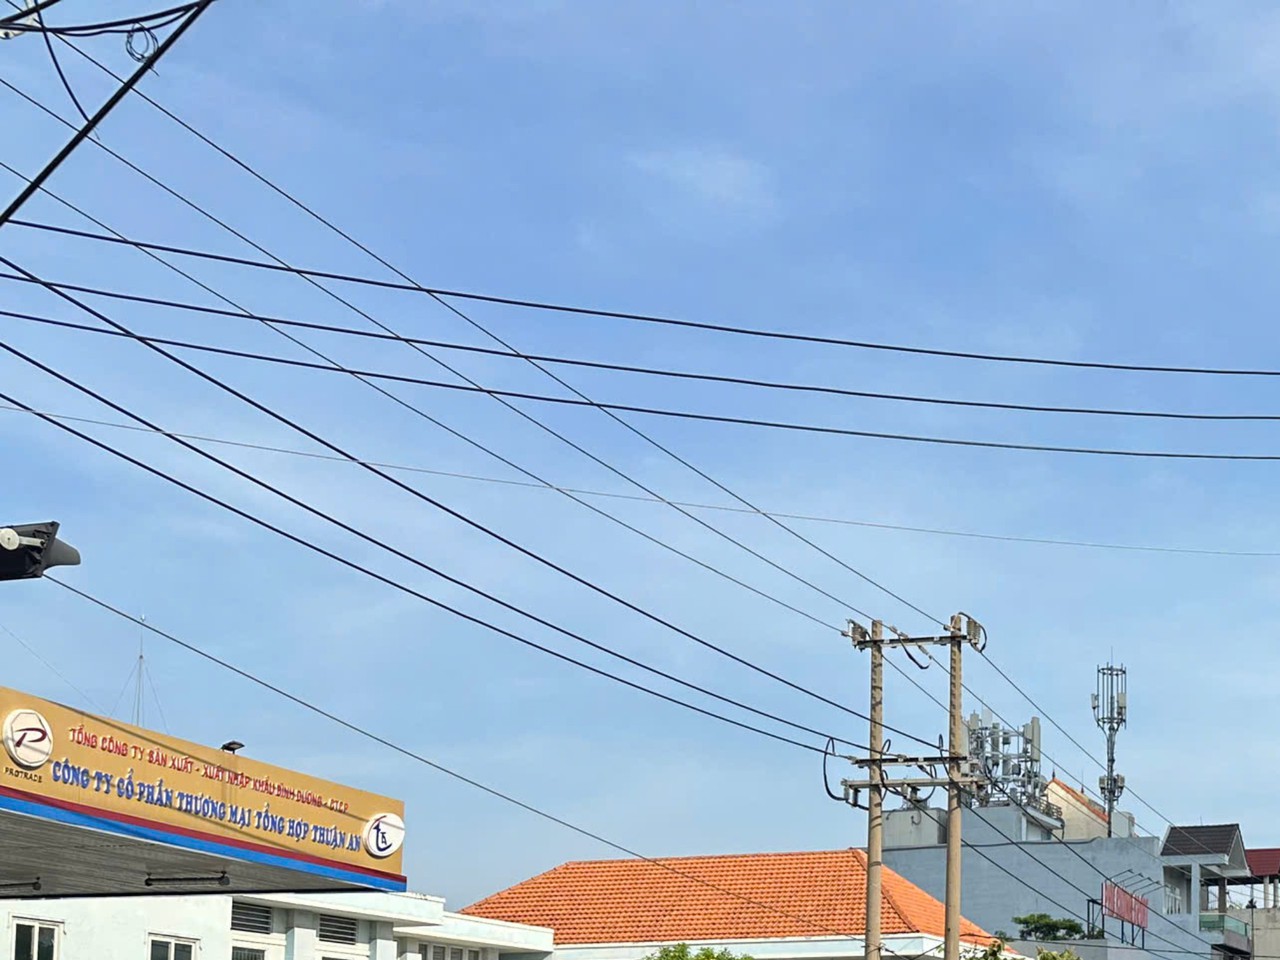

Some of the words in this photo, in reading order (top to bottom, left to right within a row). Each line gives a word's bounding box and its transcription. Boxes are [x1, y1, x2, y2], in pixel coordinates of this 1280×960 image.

[69, 724, 97, 748] TỔNG
[101, 736, 128, 757] CÔNG
[131, 745, 145, 760] TY
[148, 748, 168, 767] SẢN
[170, 755, 194, 774] XUẤT
[4, 766, 43, 784] PROTRADE
[52, 758, 90, 789] CÔNG
[94, 771, 113, 794] TY
[116, 768, 134, 800] CỔ
[137, 778, 173, 808] PHẦN
[176, 792, 226, 821] THƯƠNG
[228, 804, 252, 829] MẠI
[254, 802, 285, 833] TỔNG
[287, 817, 310, 842] HỢP
[311, 825, 346, 850] THUẬN
[347, 834, 361, 852] AN
